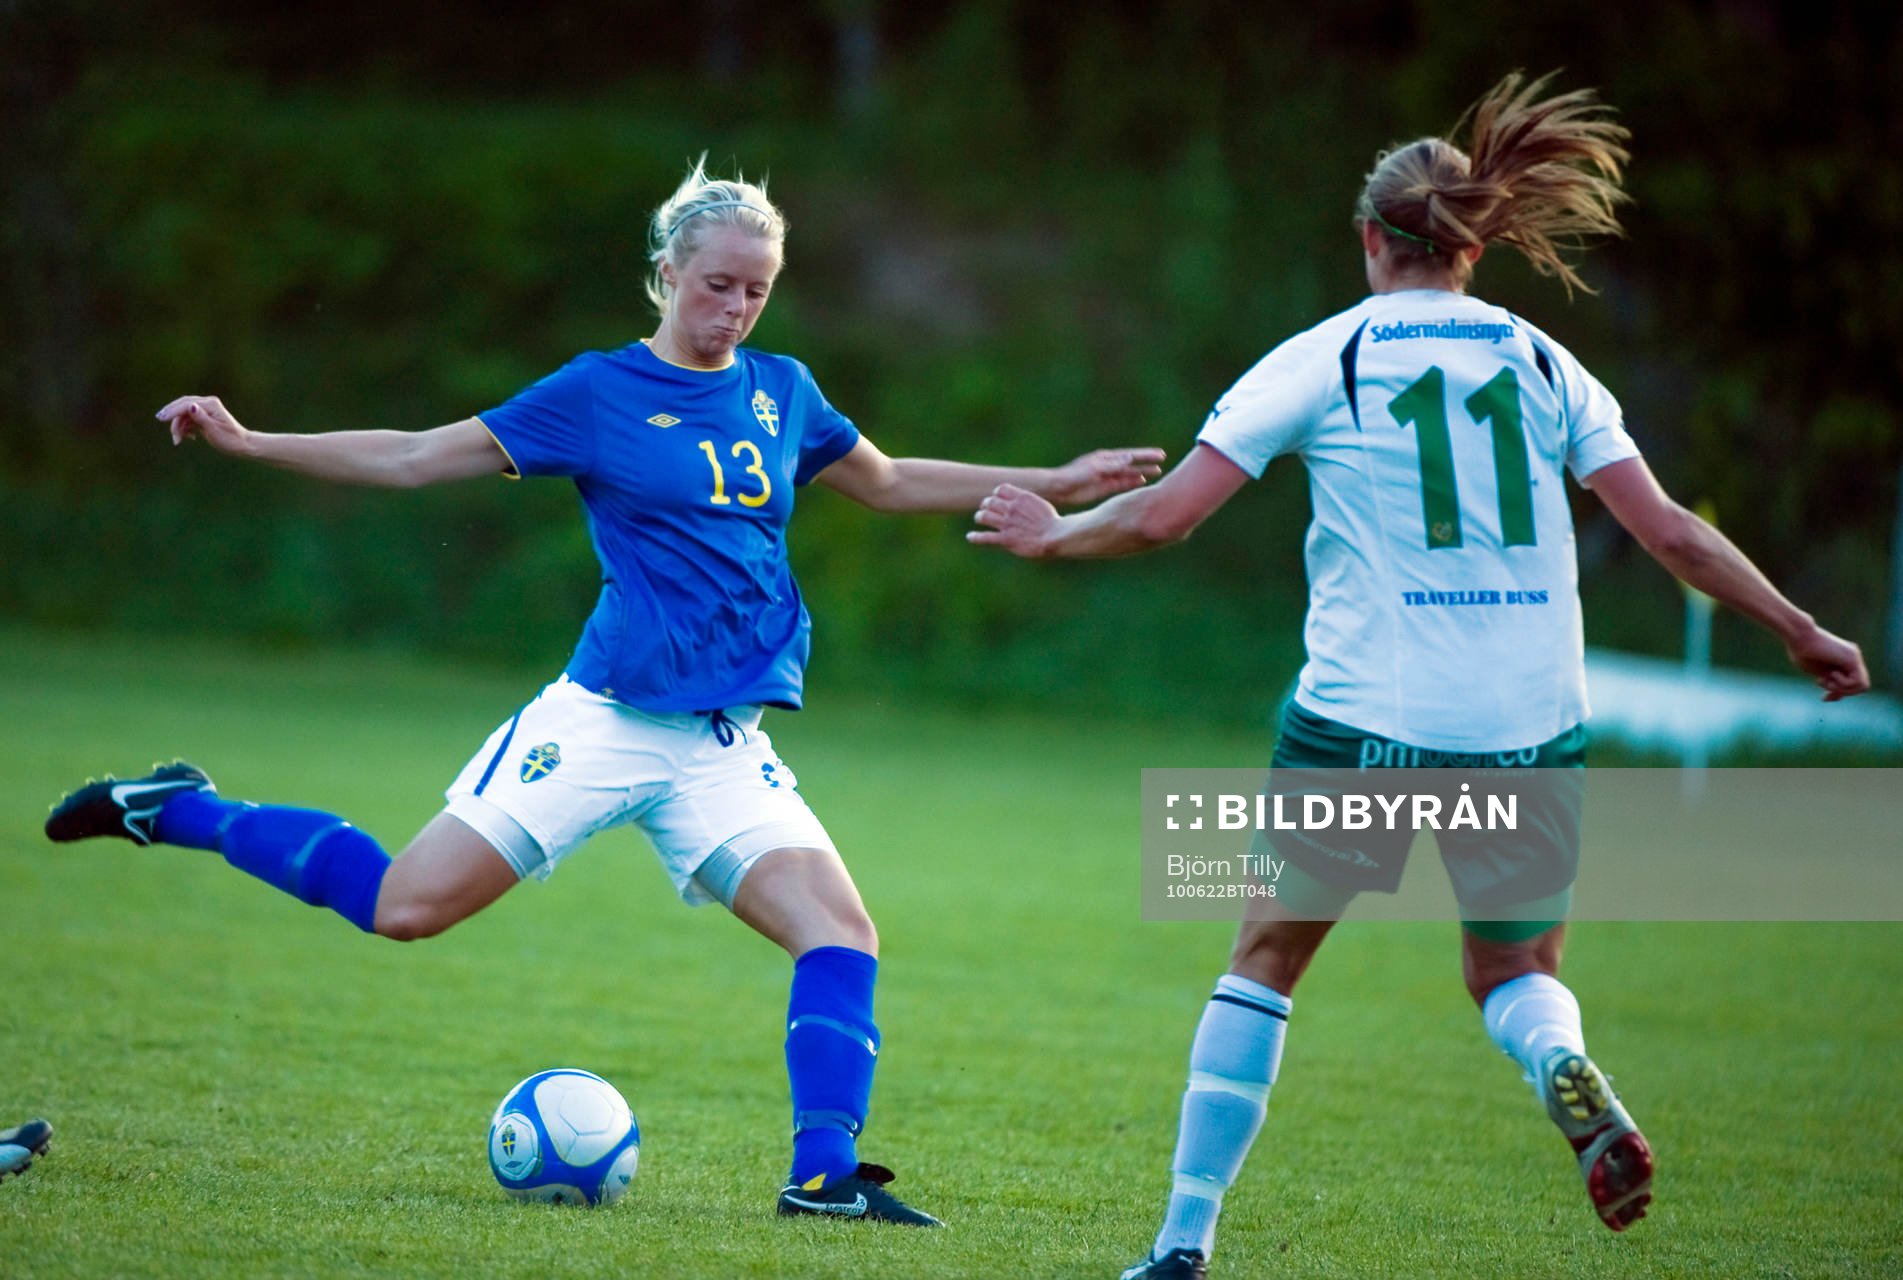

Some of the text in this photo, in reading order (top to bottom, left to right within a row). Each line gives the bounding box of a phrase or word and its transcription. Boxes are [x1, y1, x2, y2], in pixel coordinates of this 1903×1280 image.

[698, 440, 772, 507] 13
[1388, 365, 1537, 550] 11
[1402, 590, 1549, 606] TRAVELLER BUSS
